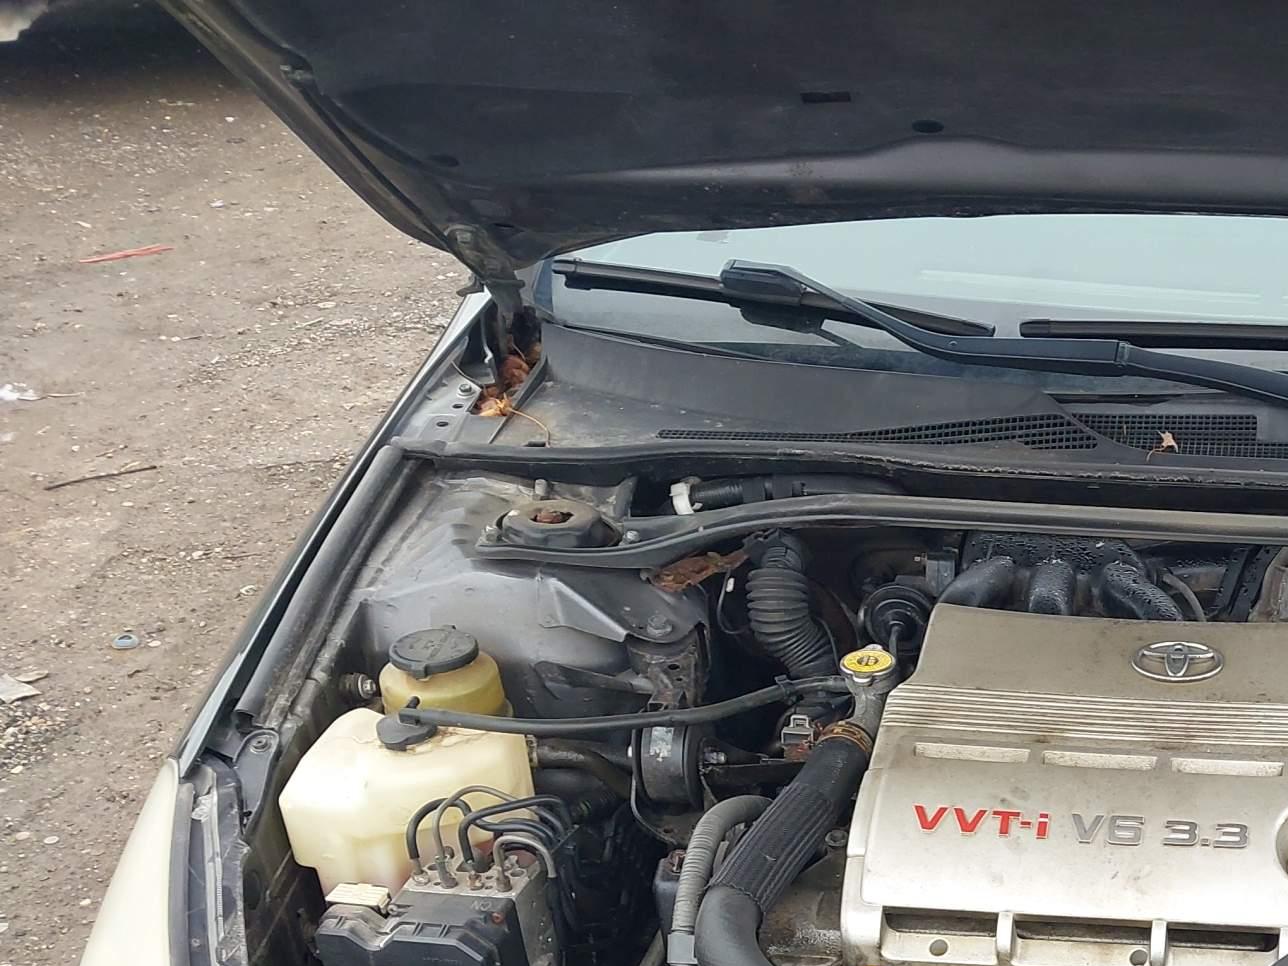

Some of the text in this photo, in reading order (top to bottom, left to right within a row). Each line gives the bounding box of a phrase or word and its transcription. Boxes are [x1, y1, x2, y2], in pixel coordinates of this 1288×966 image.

[912, 804, 1250, 849] VVT-i V6 3.3
